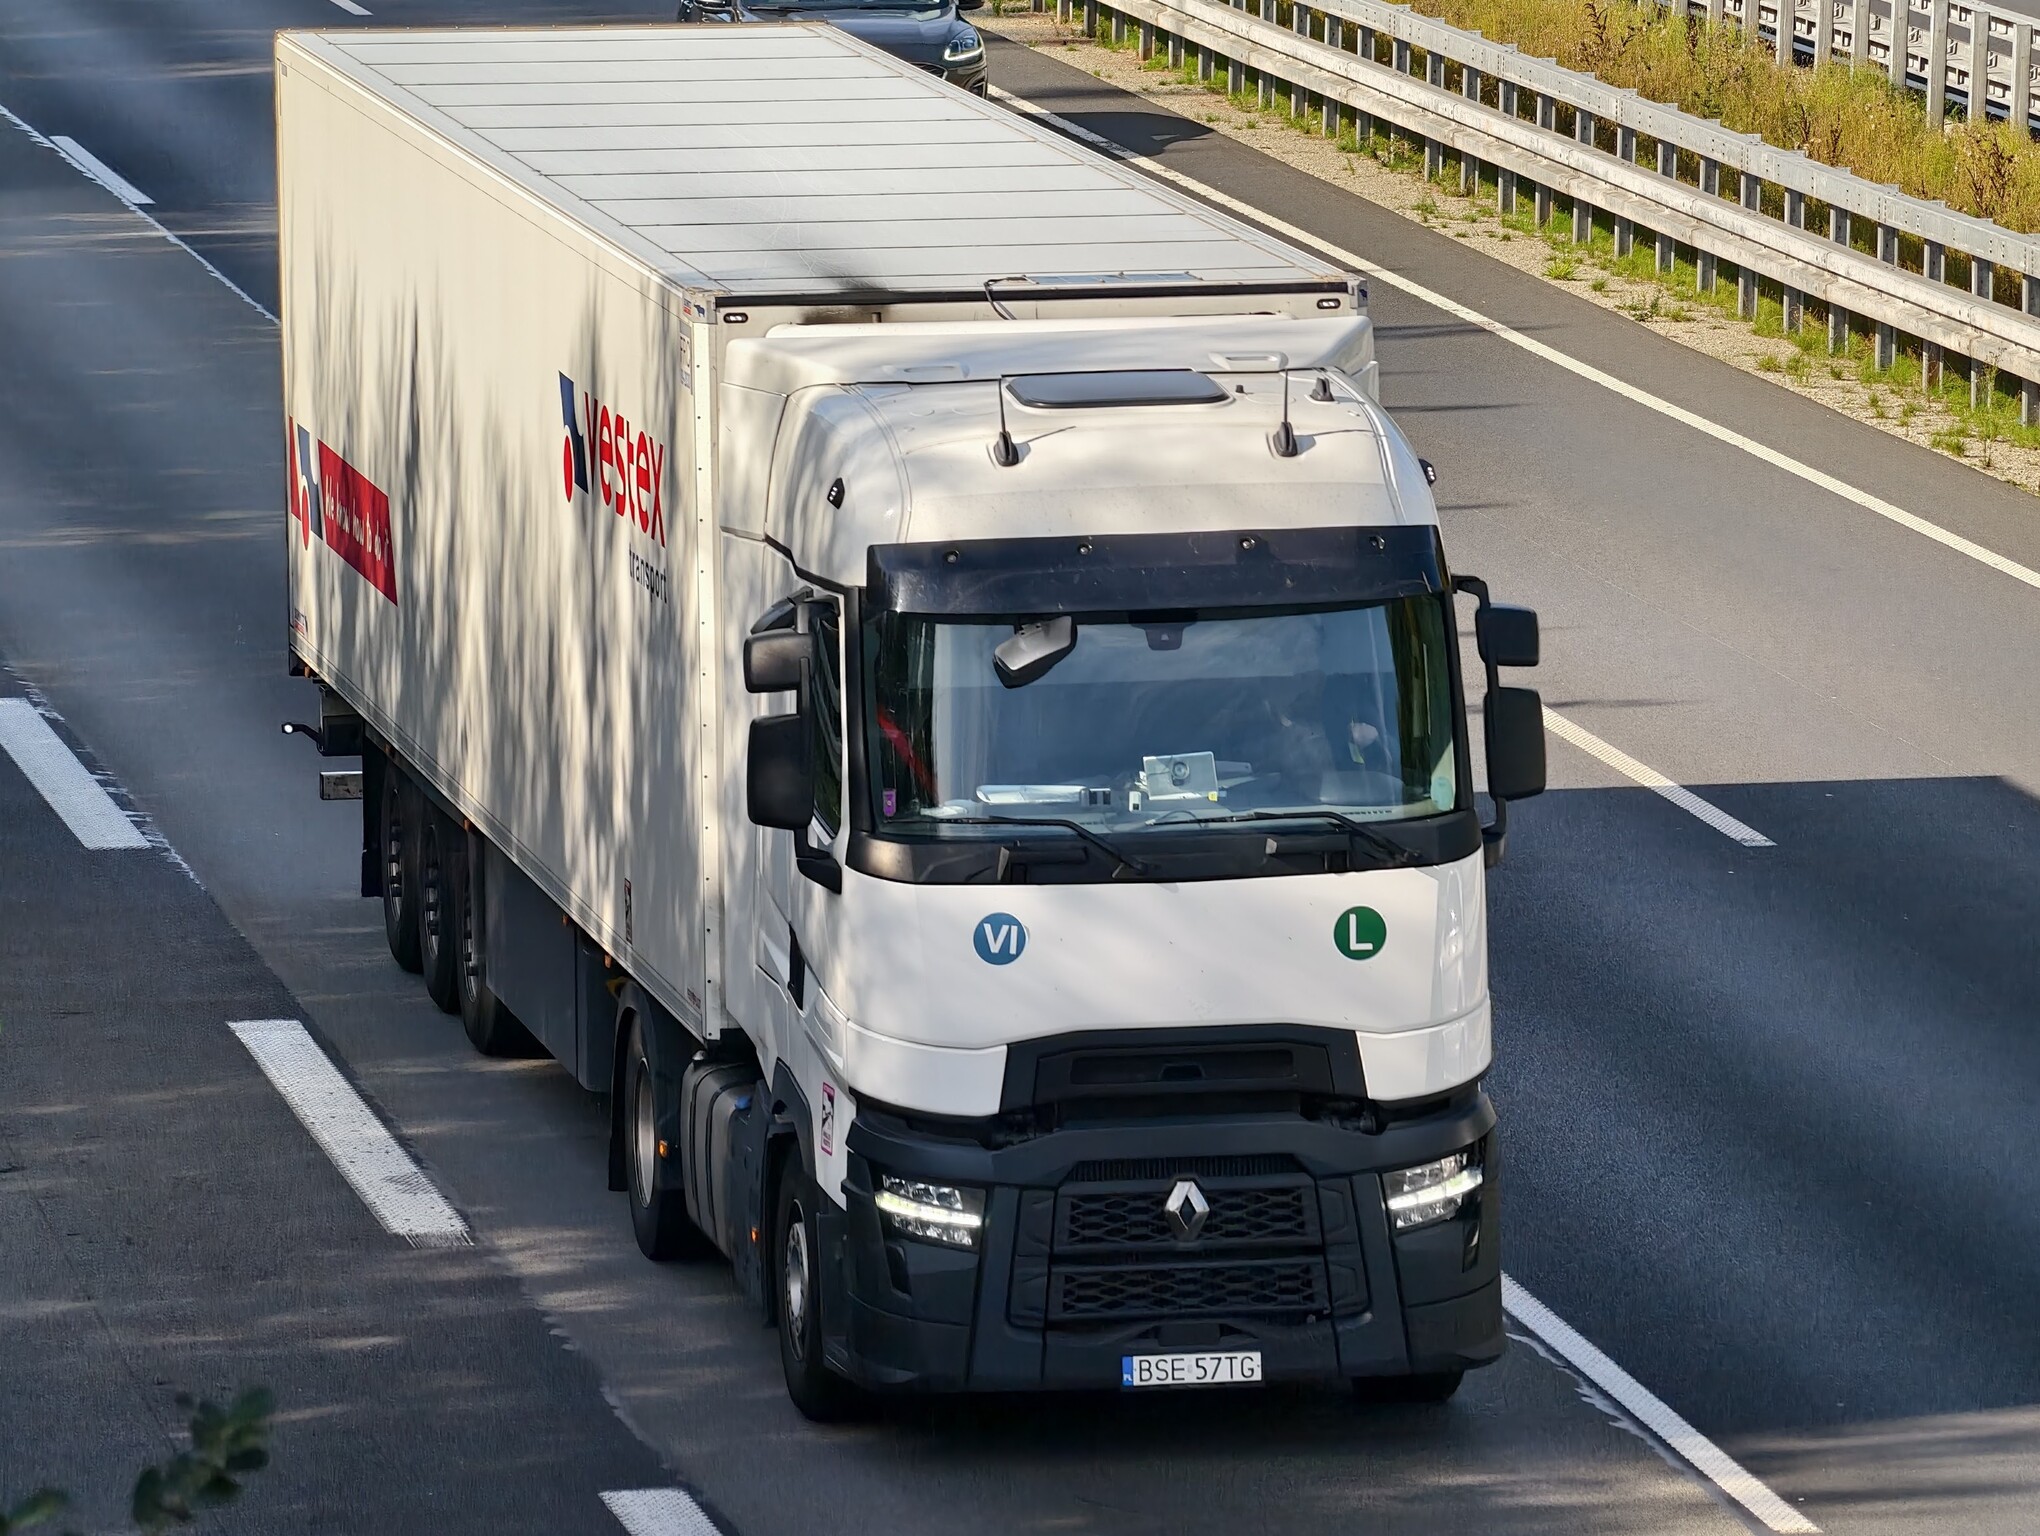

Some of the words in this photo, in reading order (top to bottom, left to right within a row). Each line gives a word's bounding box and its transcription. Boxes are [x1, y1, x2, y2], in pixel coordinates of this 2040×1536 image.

[584, 390, 666, 549] vestex
[629, 542, 668, 604] transport
[983, 922, 1018, 955] VI
[1349, 913, 1374, 951] L
[1138, 1358, 1185, 1383] BSE
[1195, 1355, 1255, 1380] 57TG
